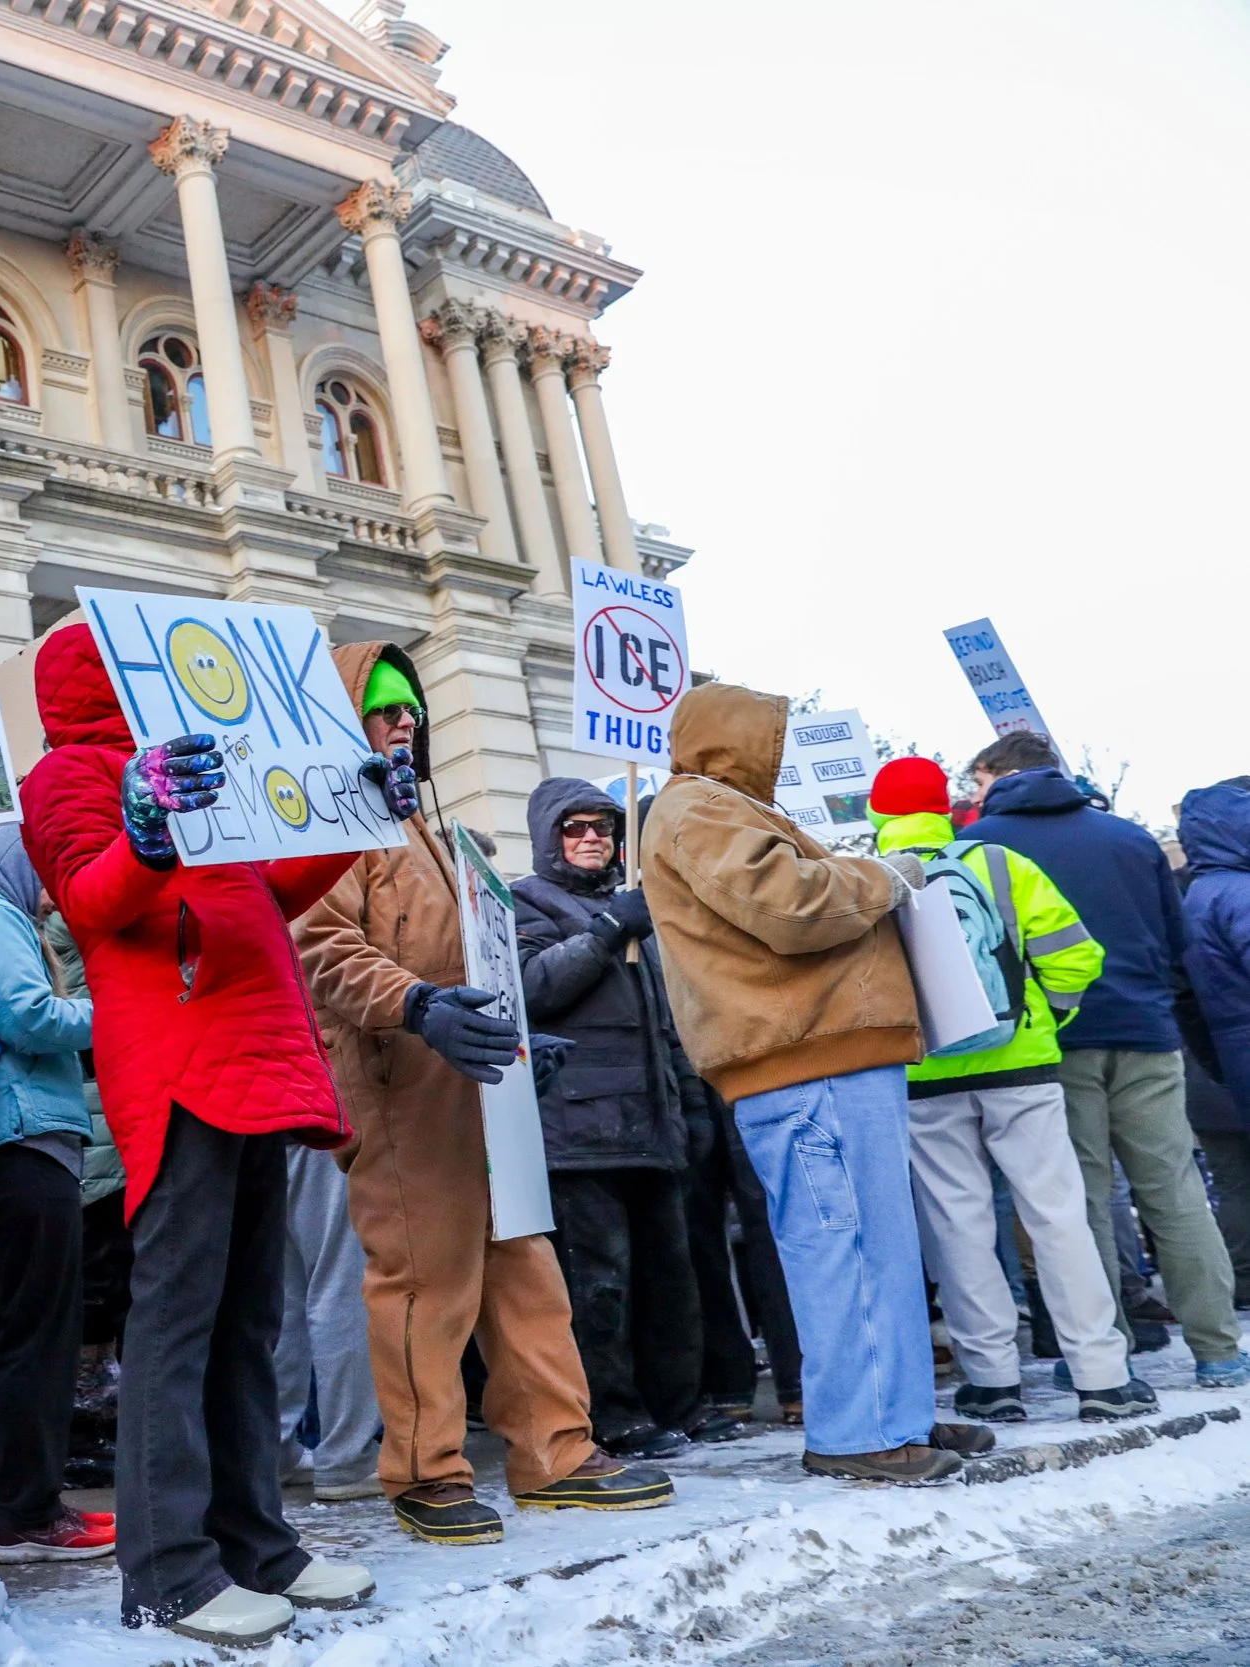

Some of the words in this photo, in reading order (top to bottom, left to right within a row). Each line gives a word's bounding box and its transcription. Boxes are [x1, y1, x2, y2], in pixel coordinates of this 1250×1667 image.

[581, 567, 674, 609] LAWLESS
[90, 598, 375, 753] HONK
[594, 624, 673, 696] ICE
[222, 734, 254, 766] for
[796, 725, 847, 744] ENOUGH
[779, 770, 797, 783] HE
[816, 760, 863, 777] WORLD
